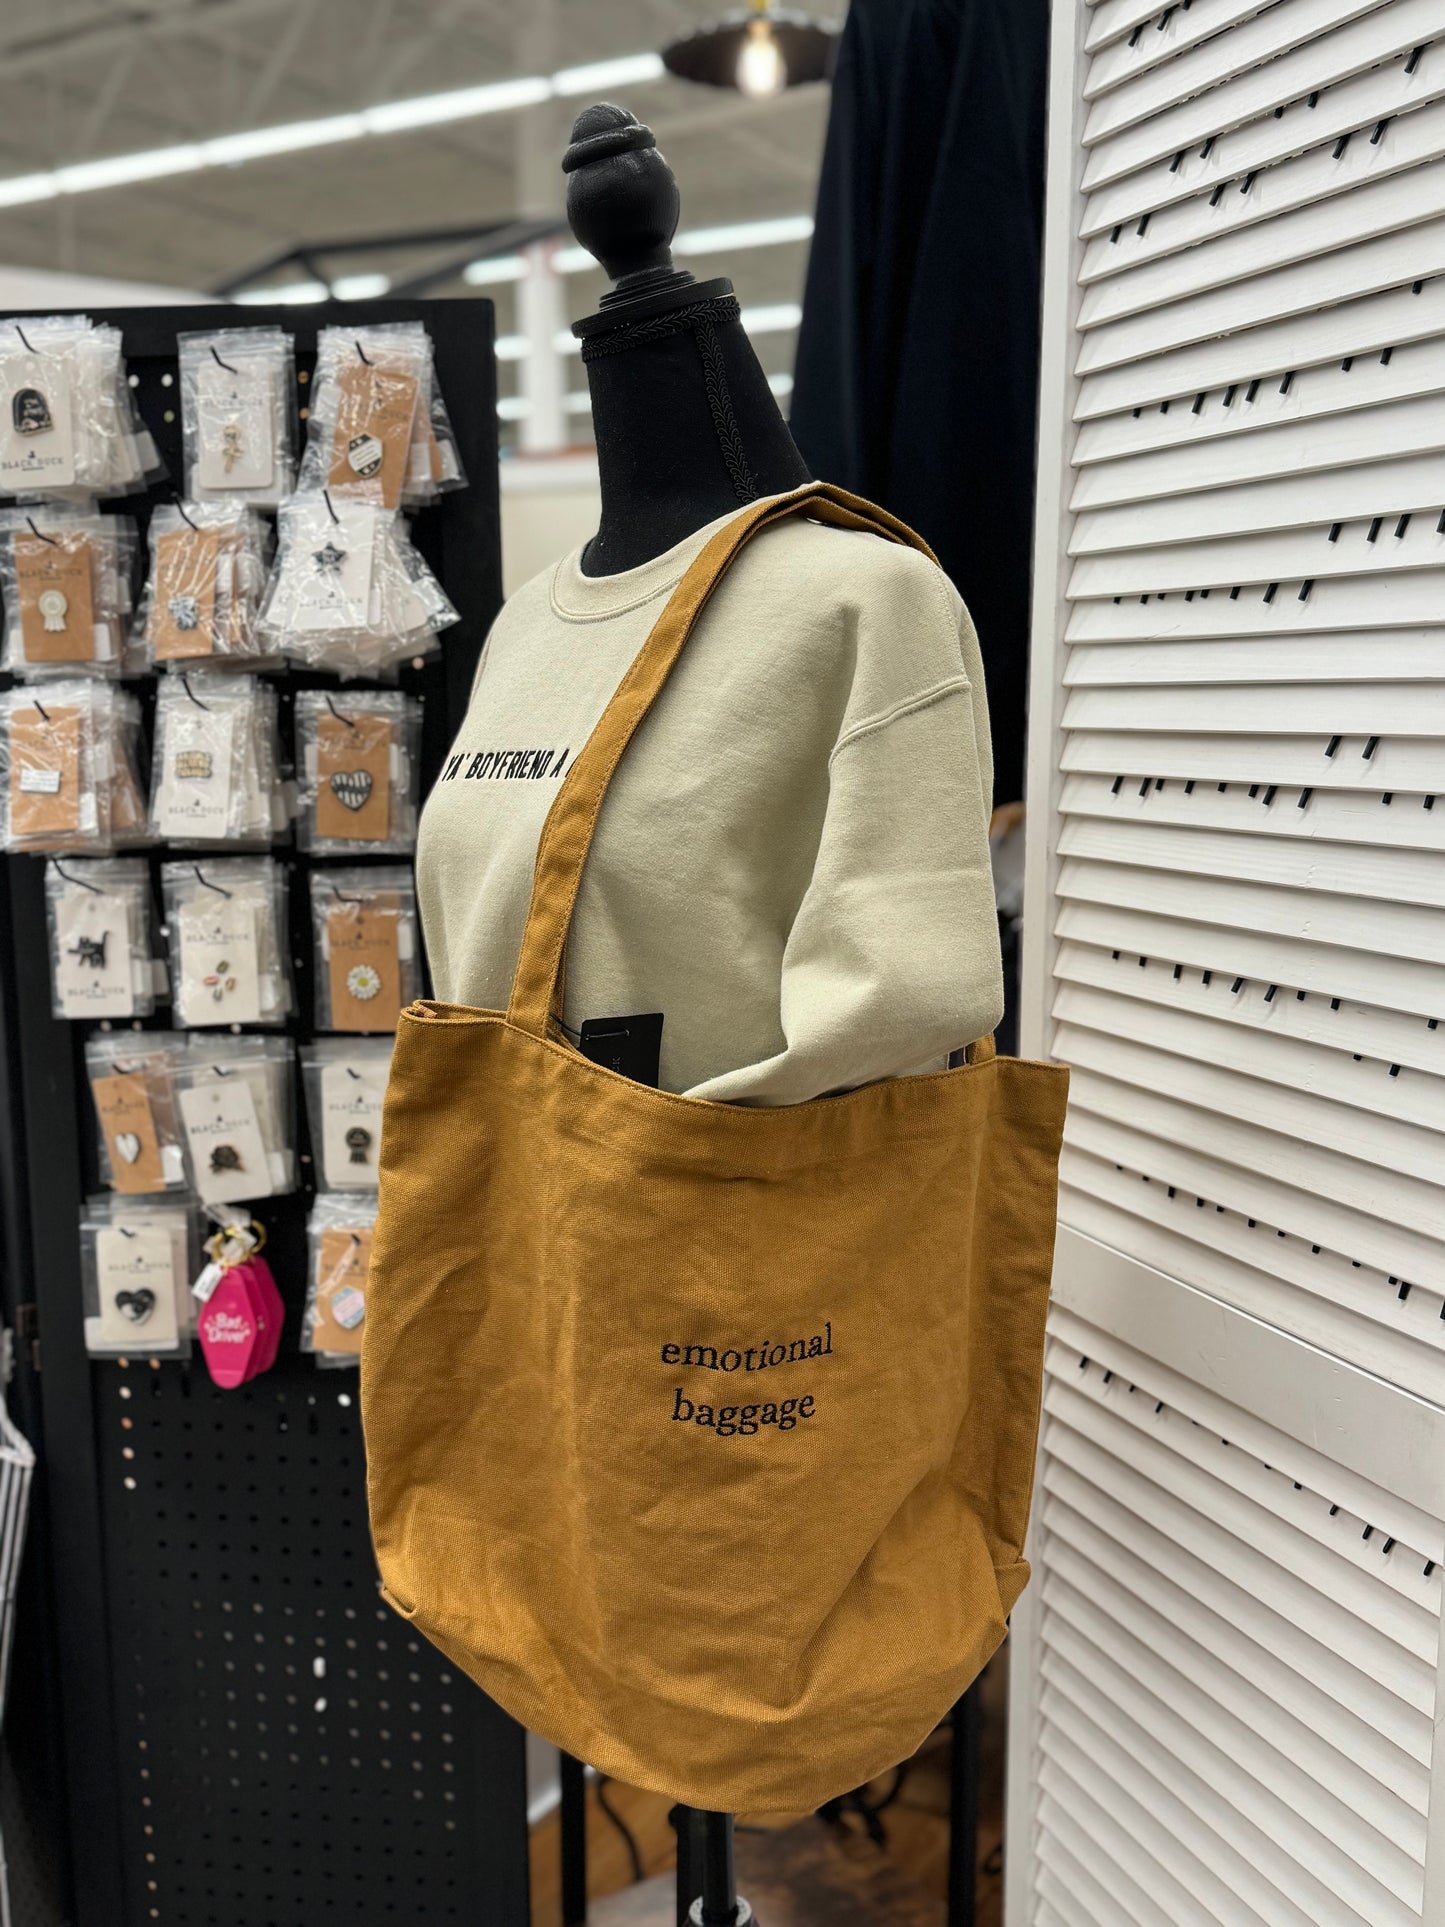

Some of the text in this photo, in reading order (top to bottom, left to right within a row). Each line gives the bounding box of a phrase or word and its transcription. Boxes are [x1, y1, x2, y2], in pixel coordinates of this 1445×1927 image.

[465, 749, 555, 780] BOYFRIEND
[549, 748, 570, 778] A
[661, 1321, 833, 1372] emotional
[672, 1387, 816, 1436] baggage
